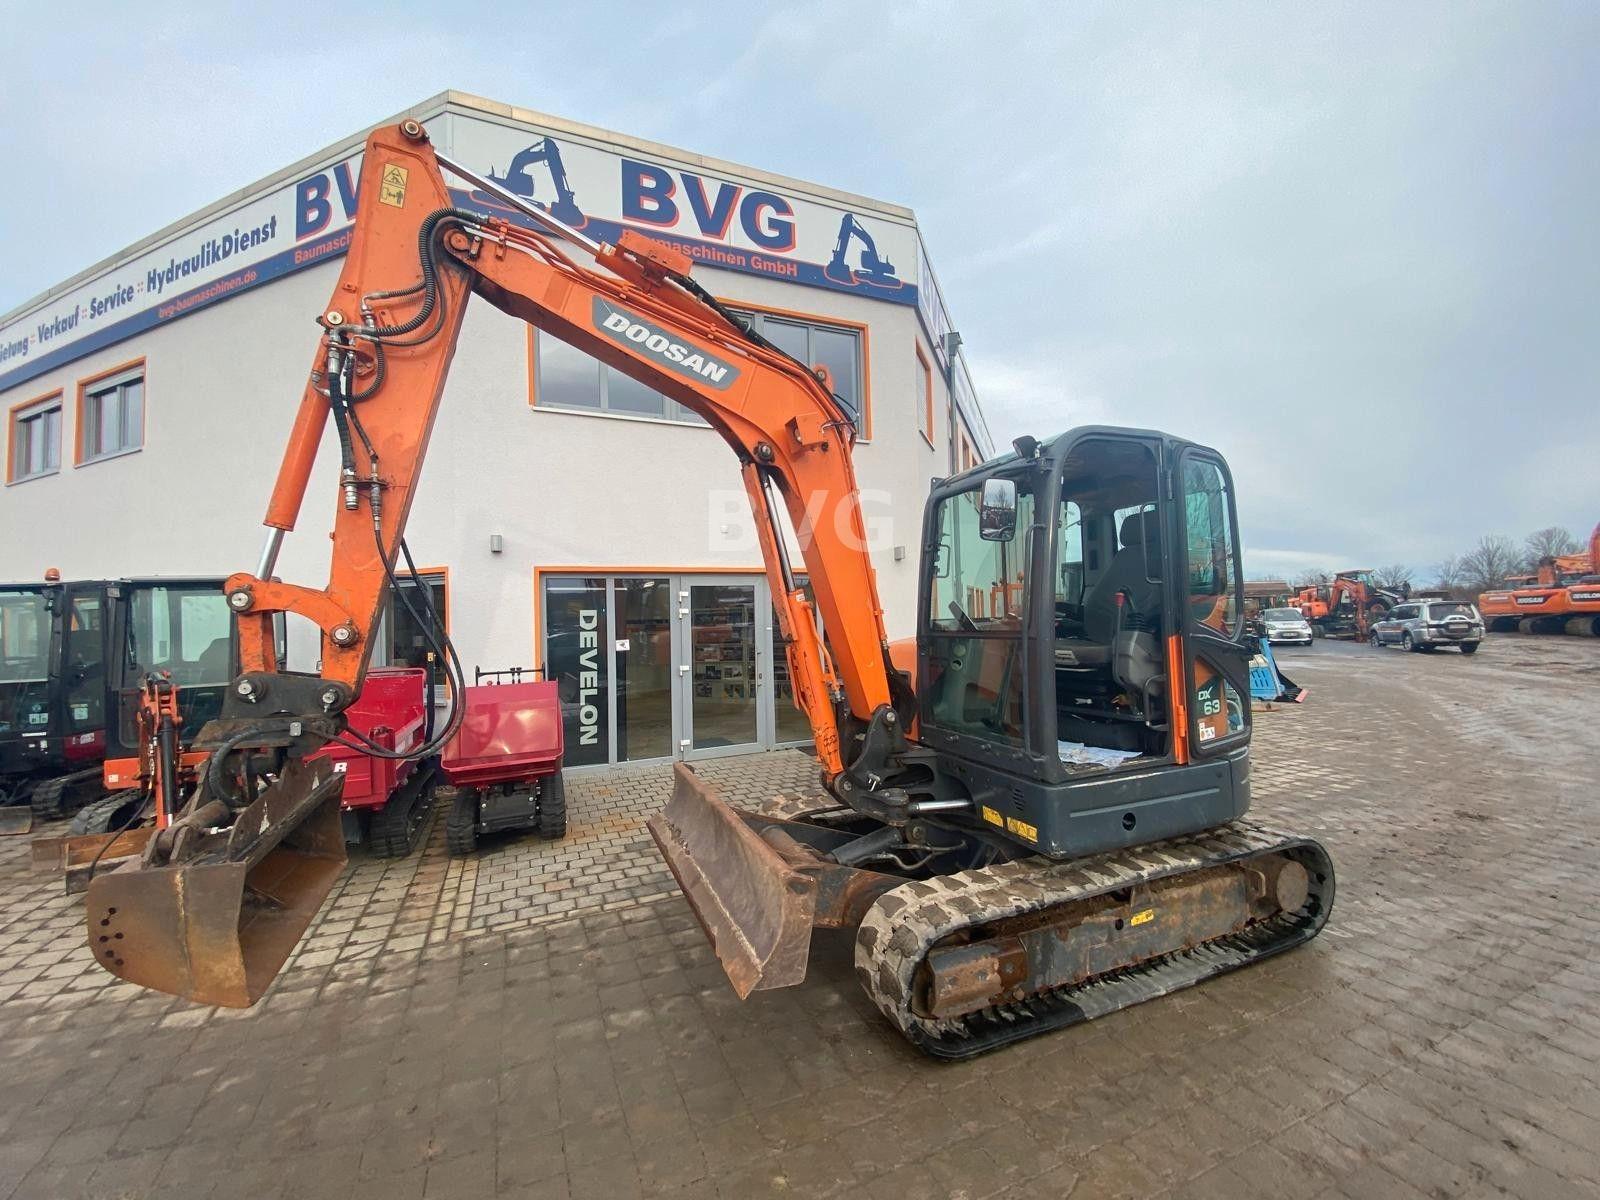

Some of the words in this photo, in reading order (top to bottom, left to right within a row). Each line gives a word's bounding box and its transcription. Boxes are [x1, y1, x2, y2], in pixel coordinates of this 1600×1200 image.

[621, 158, 797, 254] BVG
[37, 304, 80, 343] Verkauf
[89, 285, 135, 320] Service
[147, 215, 277, 294] HydraulikDienst
[750, 255, 798, 277] GmbH
[602, 312, 728, 383] DOOSAN
[579, 609, 599, 746] DEVELON
[1198, 686, 1213, 700] DX
[1203, 699, 1221, 715] 63
